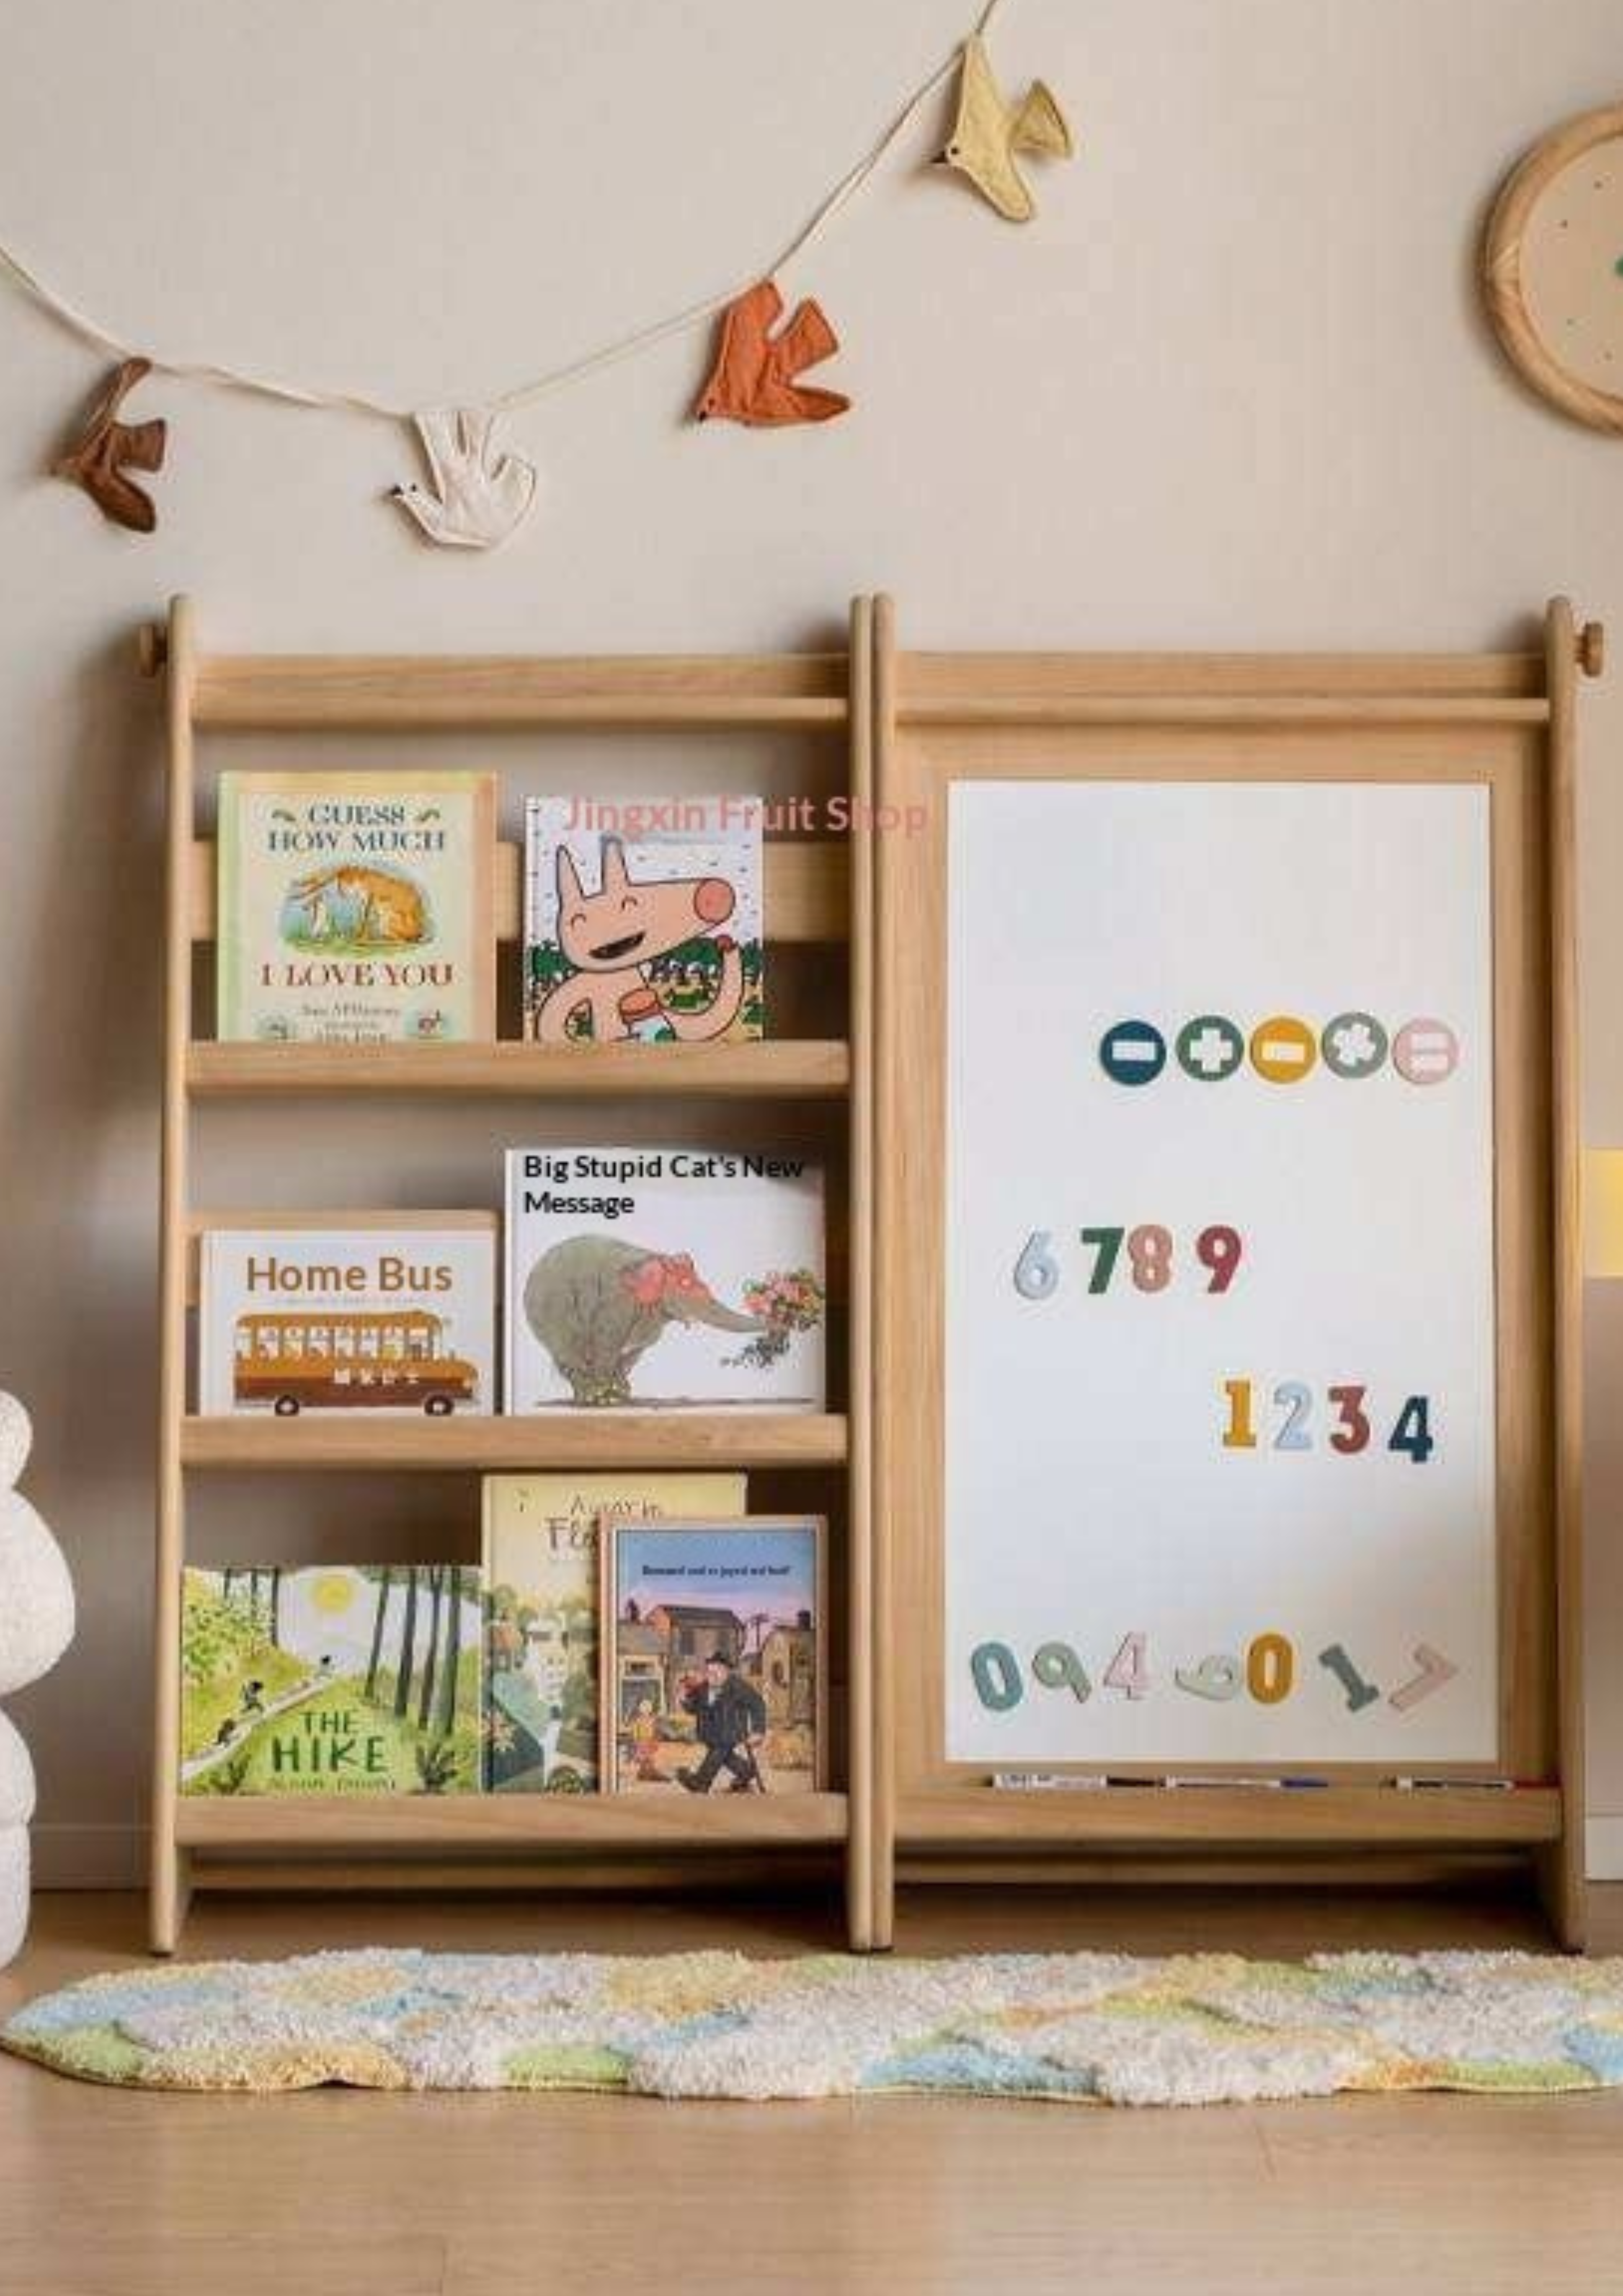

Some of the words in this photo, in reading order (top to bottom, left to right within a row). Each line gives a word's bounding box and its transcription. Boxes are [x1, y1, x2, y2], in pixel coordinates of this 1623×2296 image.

[308, 805, 405, 825] GUESS
[269, 831, 338, 851] HOW
[353, 831, 444, 851] MUCH
[262, 963, 271, 987] I
[286, 963, 375, 987] LOVE
[384, 963, 452, 987] YOU
[525, 1155, 569, 1183] Big
[575, 1155, 662, 1183] Stupid
[670, 1155, 736, 1178] Cat's
[744, 1156, 805, 1178] New
[525, 1191, 635, 1219] Message
[247, 1257, 367, 1291] Home
[379, 1257, 452, 1291] Bus
[1013, 1231, 1058, 1300] 6
[1081, 1227, 1125, 1294] 7
[1127, 1224, 1174, 1293] 8
[1196, 1225, 1243, 1294] 9
[1223, 1380, 1257, 1448] 1
[1273, 1382, 1313, 1449] 2
[1328, 1386, 1370, 1454] 3
[1388, 1395, 1434, 1464] 4
[1102, 1632, 1146, 1700] 4
[1247, 1633, 1293, 1705] 0
[1319, 1645, 1380, 1712] 1
[299, 1710, 359, 1734] THE
[271, 1736, 389, 1773] HIKE
